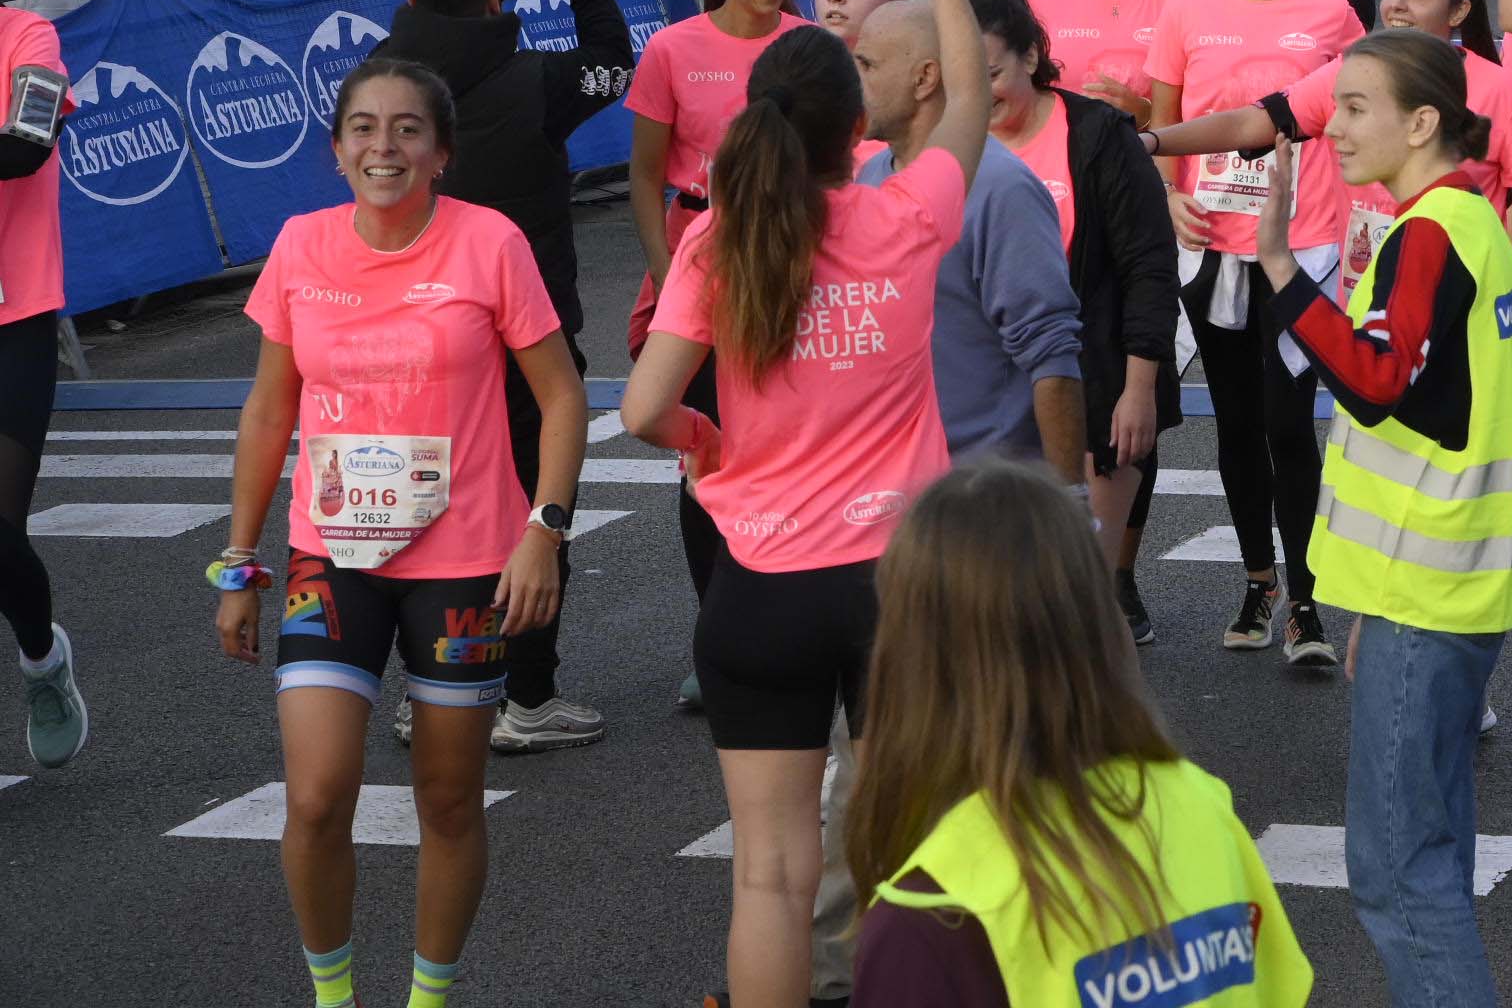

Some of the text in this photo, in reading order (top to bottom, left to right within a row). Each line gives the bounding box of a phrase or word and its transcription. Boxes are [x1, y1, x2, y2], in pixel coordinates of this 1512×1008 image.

[687, 71, 735, 82] OYSHO
[199, 89, 303, 141] ASTURIANA
[1231, 156, 1265, 173] 016
[1233, 173, 1260, 184] 32131
[1207, 183, 1233, 192] CARRERA
[1234, 185, 1243, 193] DE
[302, 285, 363, 307] OYSHO
[811, 278, 901, 308] RRERA
[797, 307, 880, 336] DE LA
[792, 331, 887, 361] MUJER
[830, 360, 854, 371] 2023
[346, 451, 401, 470] ASTURIANA
[411, 453, 440, 462] SUMA
[348, 487, 397, 507] 016
[353, 512, 391, 524] 12632
[320, 529, 411, 538] CARRERA DE LA MUJER
